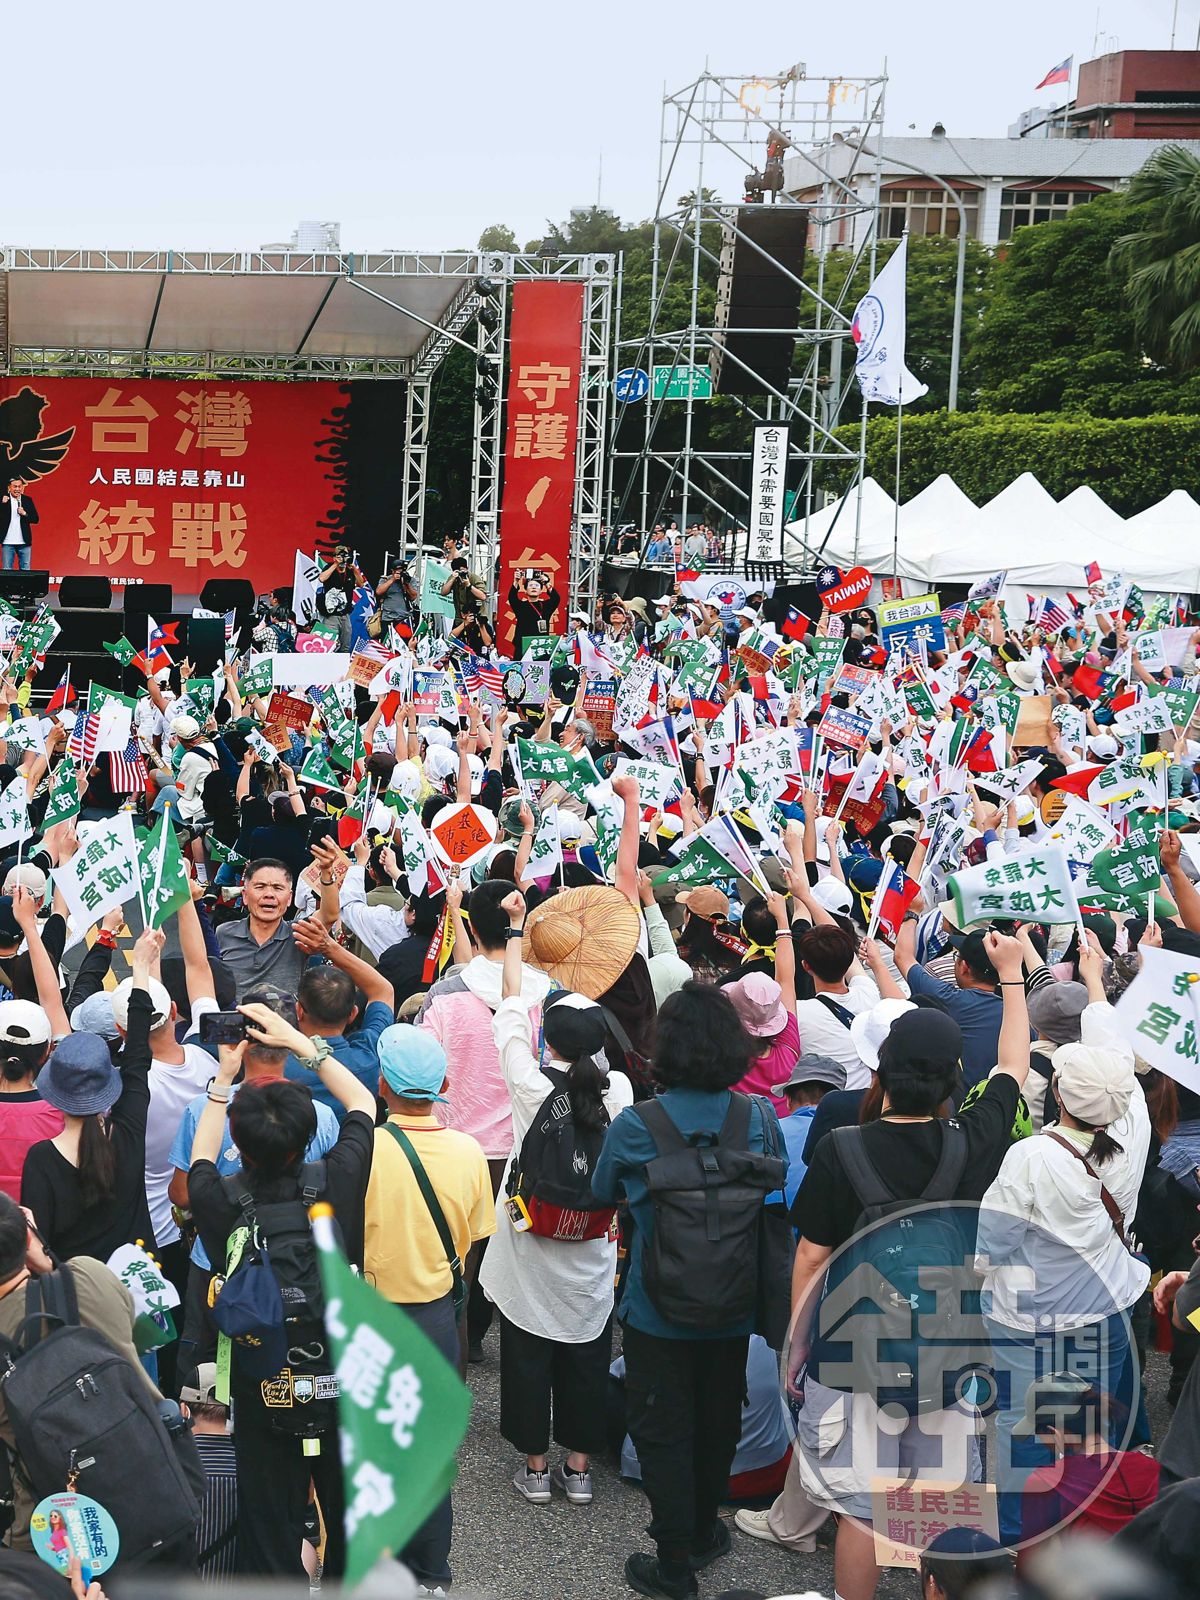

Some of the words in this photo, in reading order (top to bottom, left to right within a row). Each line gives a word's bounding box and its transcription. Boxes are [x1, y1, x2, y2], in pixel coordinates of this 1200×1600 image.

[85, 388, 253, 456] 台灣
[514, 361, 571, 460] 守護
[89, 467, 246, 488] 人民團結是靠山
[77, 500, 248, 567] 統戰
[825, 576, 871, 606] TAIWAN
[886, 603, 933, 622] 我台灣人
[523, 757, 569, 773] 大成宮
[886, 1485, 983, 1518] 護民主
[83, 1506, 108, 1558] 我家有的
